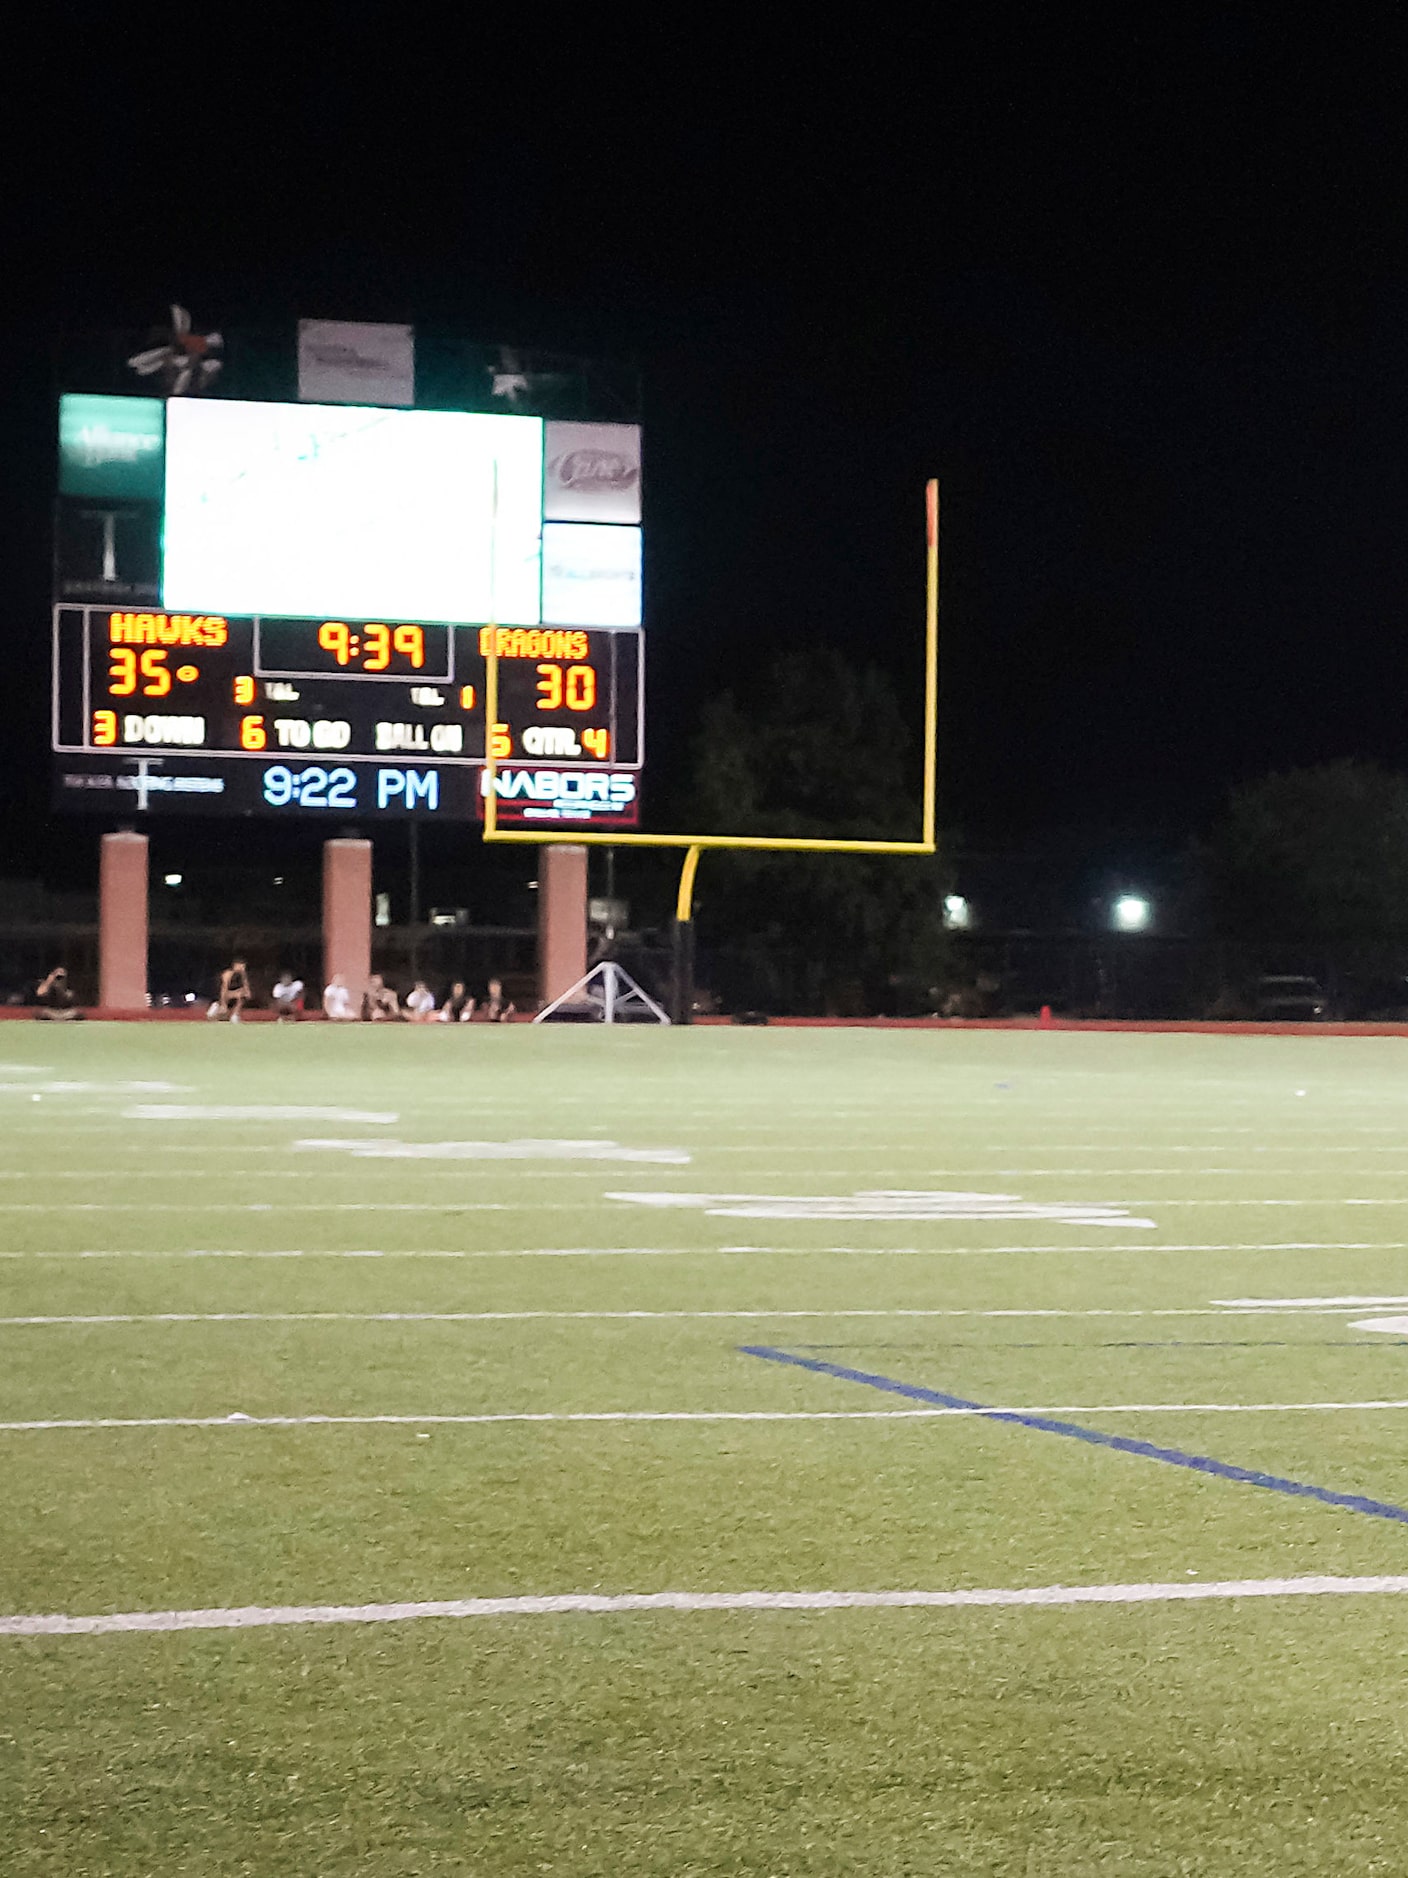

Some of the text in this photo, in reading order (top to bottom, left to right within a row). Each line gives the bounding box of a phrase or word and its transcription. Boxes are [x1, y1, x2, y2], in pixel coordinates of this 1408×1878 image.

[109, 612, 229, 647] HAWKS
[318, 621, 424, 671] 9:39
[479, 627, 589, 660] DRAGONS
[109, 648, 171, 696] 35
[234, 675, 255, 704] 3
[536, 664, 596, 710] 30
[93, 710, 205, 745] 3 DOWN
[239, 715, 351, 750] 6 TO GO
[580, 727, 610, 759] 4
[263, 765, 357, 808] 9:22
[377, 768, 438, 810] PM
[481, 768, 635, 802] NABORS
